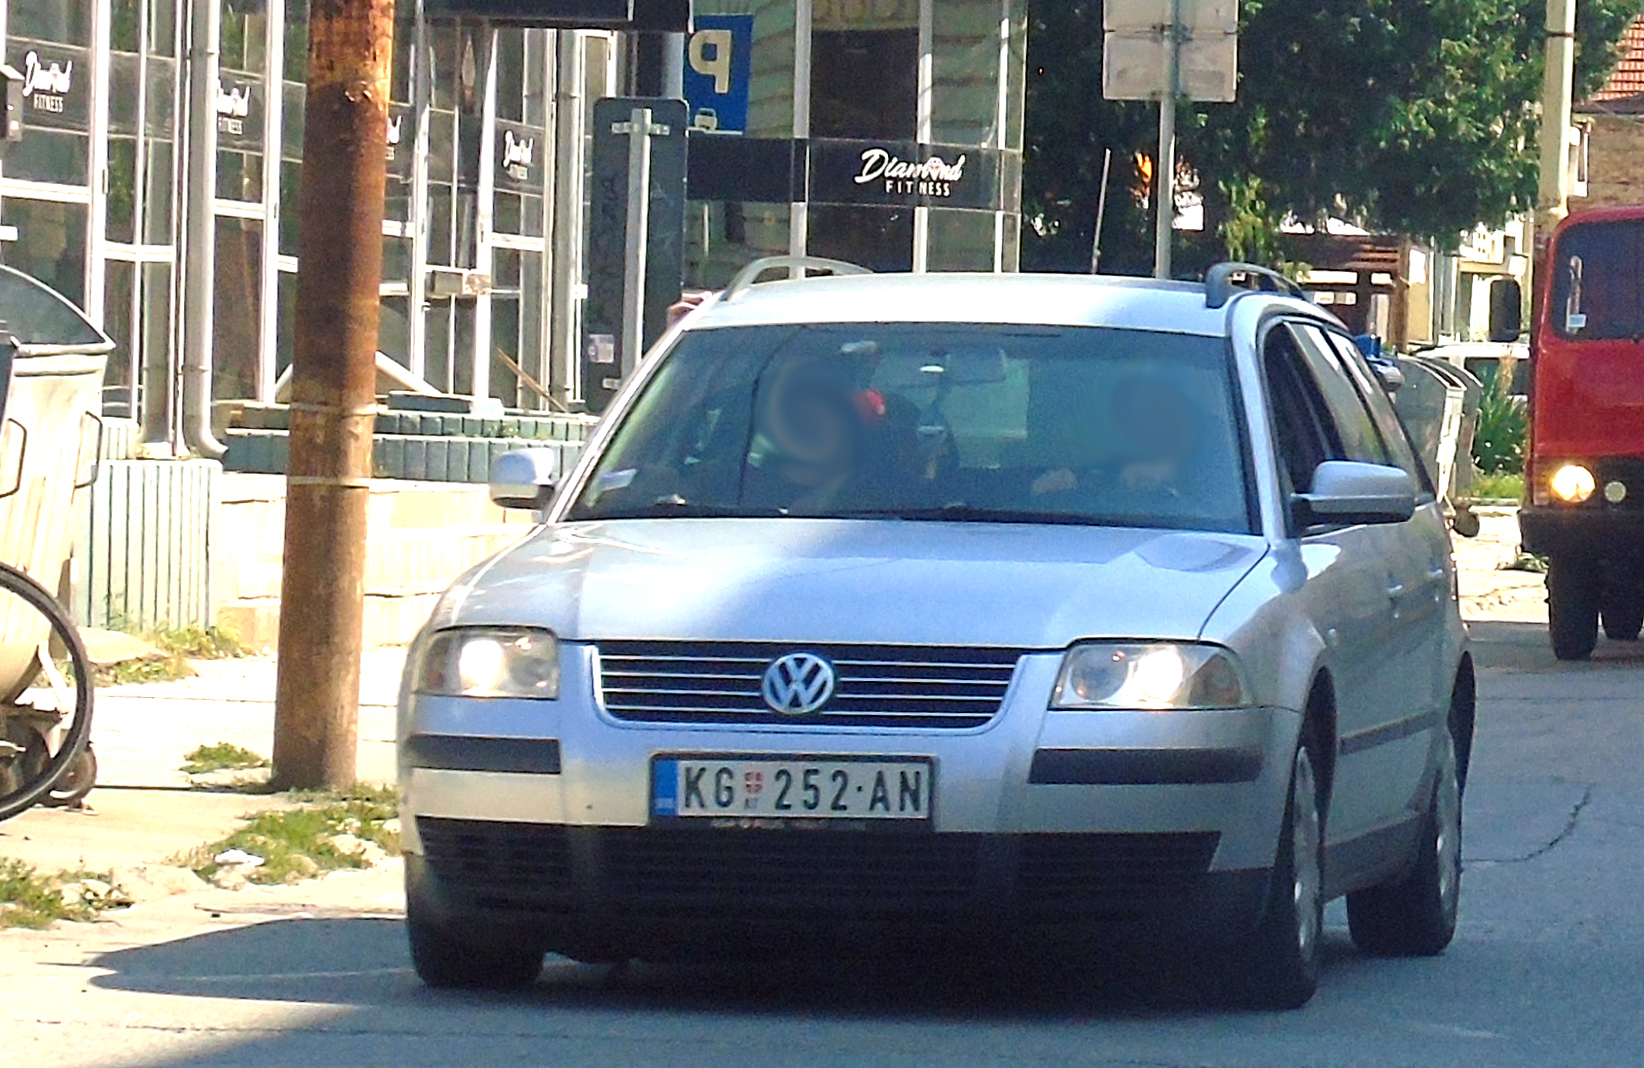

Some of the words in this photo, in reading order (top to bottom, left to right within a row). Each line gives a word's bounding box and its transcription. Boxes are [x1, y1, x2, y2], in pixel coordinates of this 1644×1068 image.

[854, 148, 966, 183] Diamond
[885, 180, 951, 197] FITNESS
[684, 767, 735, 809] KG
